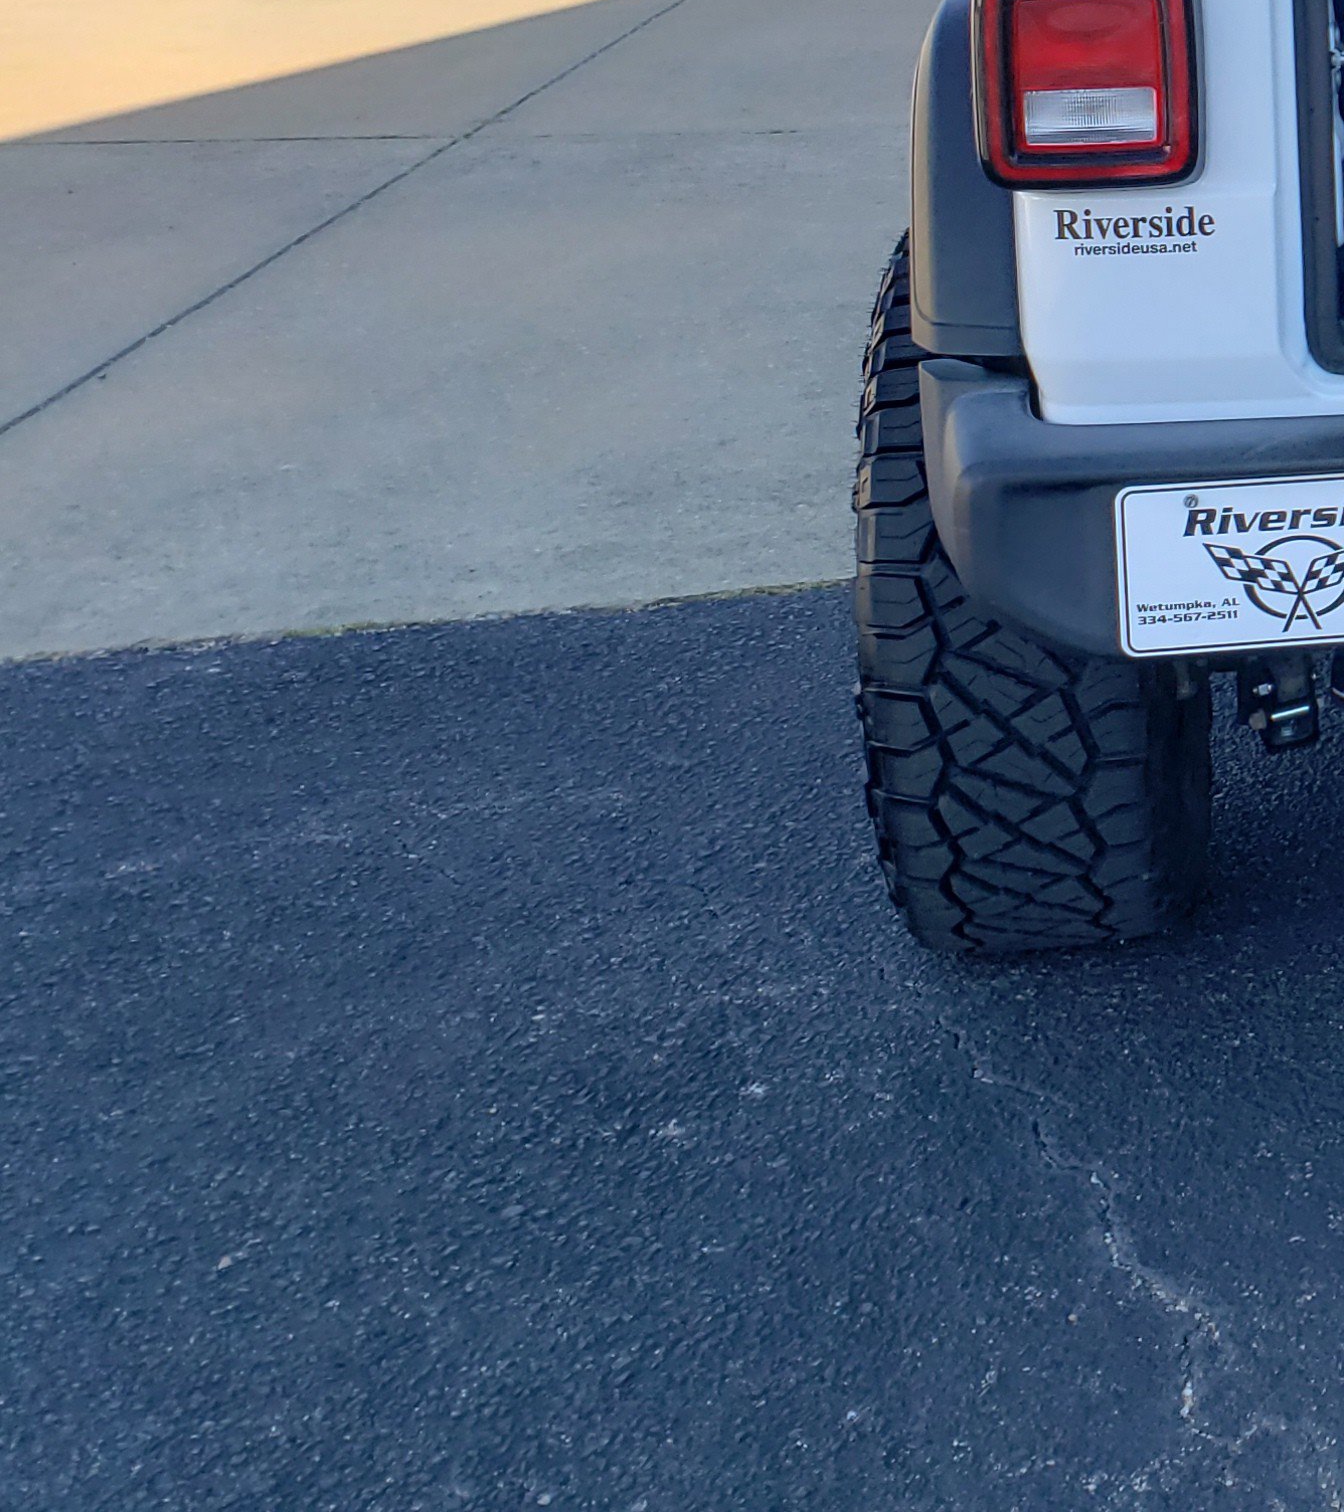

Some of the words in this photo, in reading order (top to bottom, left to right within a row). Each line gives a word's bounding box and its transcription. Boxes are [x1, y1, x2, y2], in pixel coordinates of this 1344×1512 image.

[1053, 206, 1216, 240] Riverside
[1074, 241, 1197, 256] riversideusa.net
[1136, 600, 1216, 613] Wetumpka,
[1221, 598, 1240, 607] AL
[1138, 609, 1238, 625] 334-567-2511
